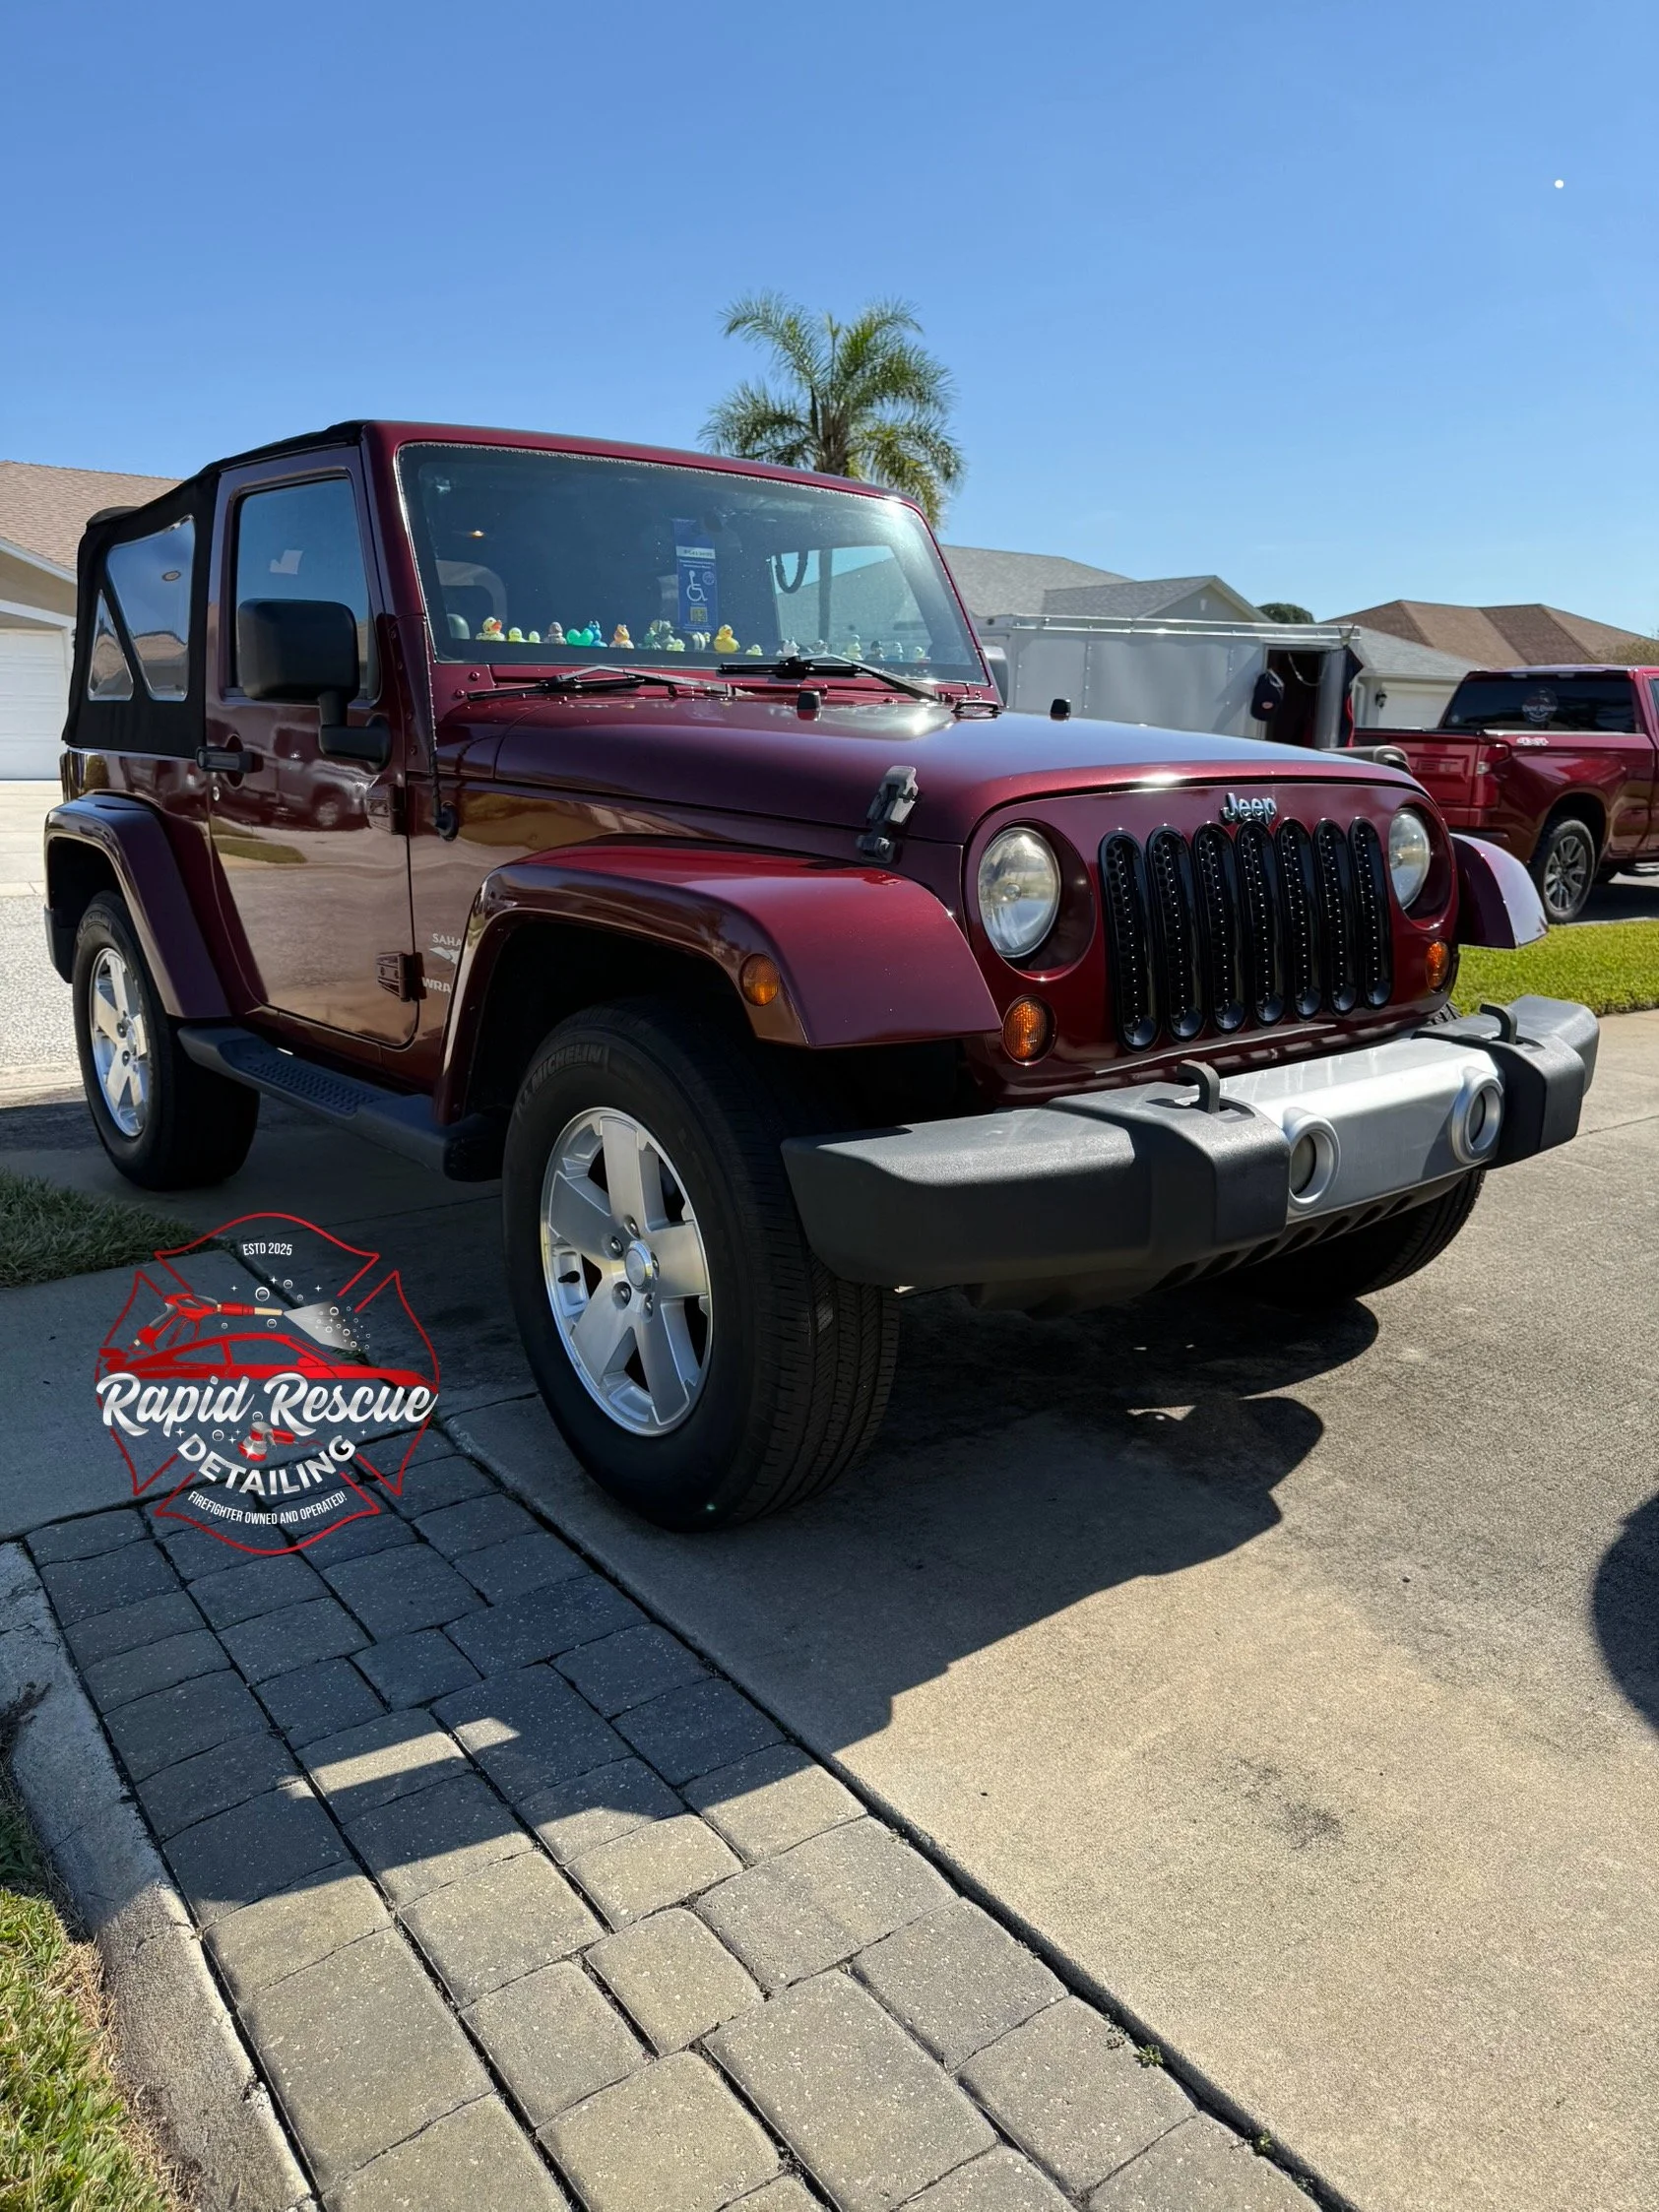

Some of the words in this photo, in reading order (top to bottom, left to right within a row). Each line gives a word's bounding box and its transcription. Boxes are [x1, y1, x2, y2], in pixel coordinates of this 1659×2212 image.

[1221, 792, 1278, 824] Jeep
[432, 933, 462, 946] SAHA
[532, 1043, 604, 1093] MICHELIN
